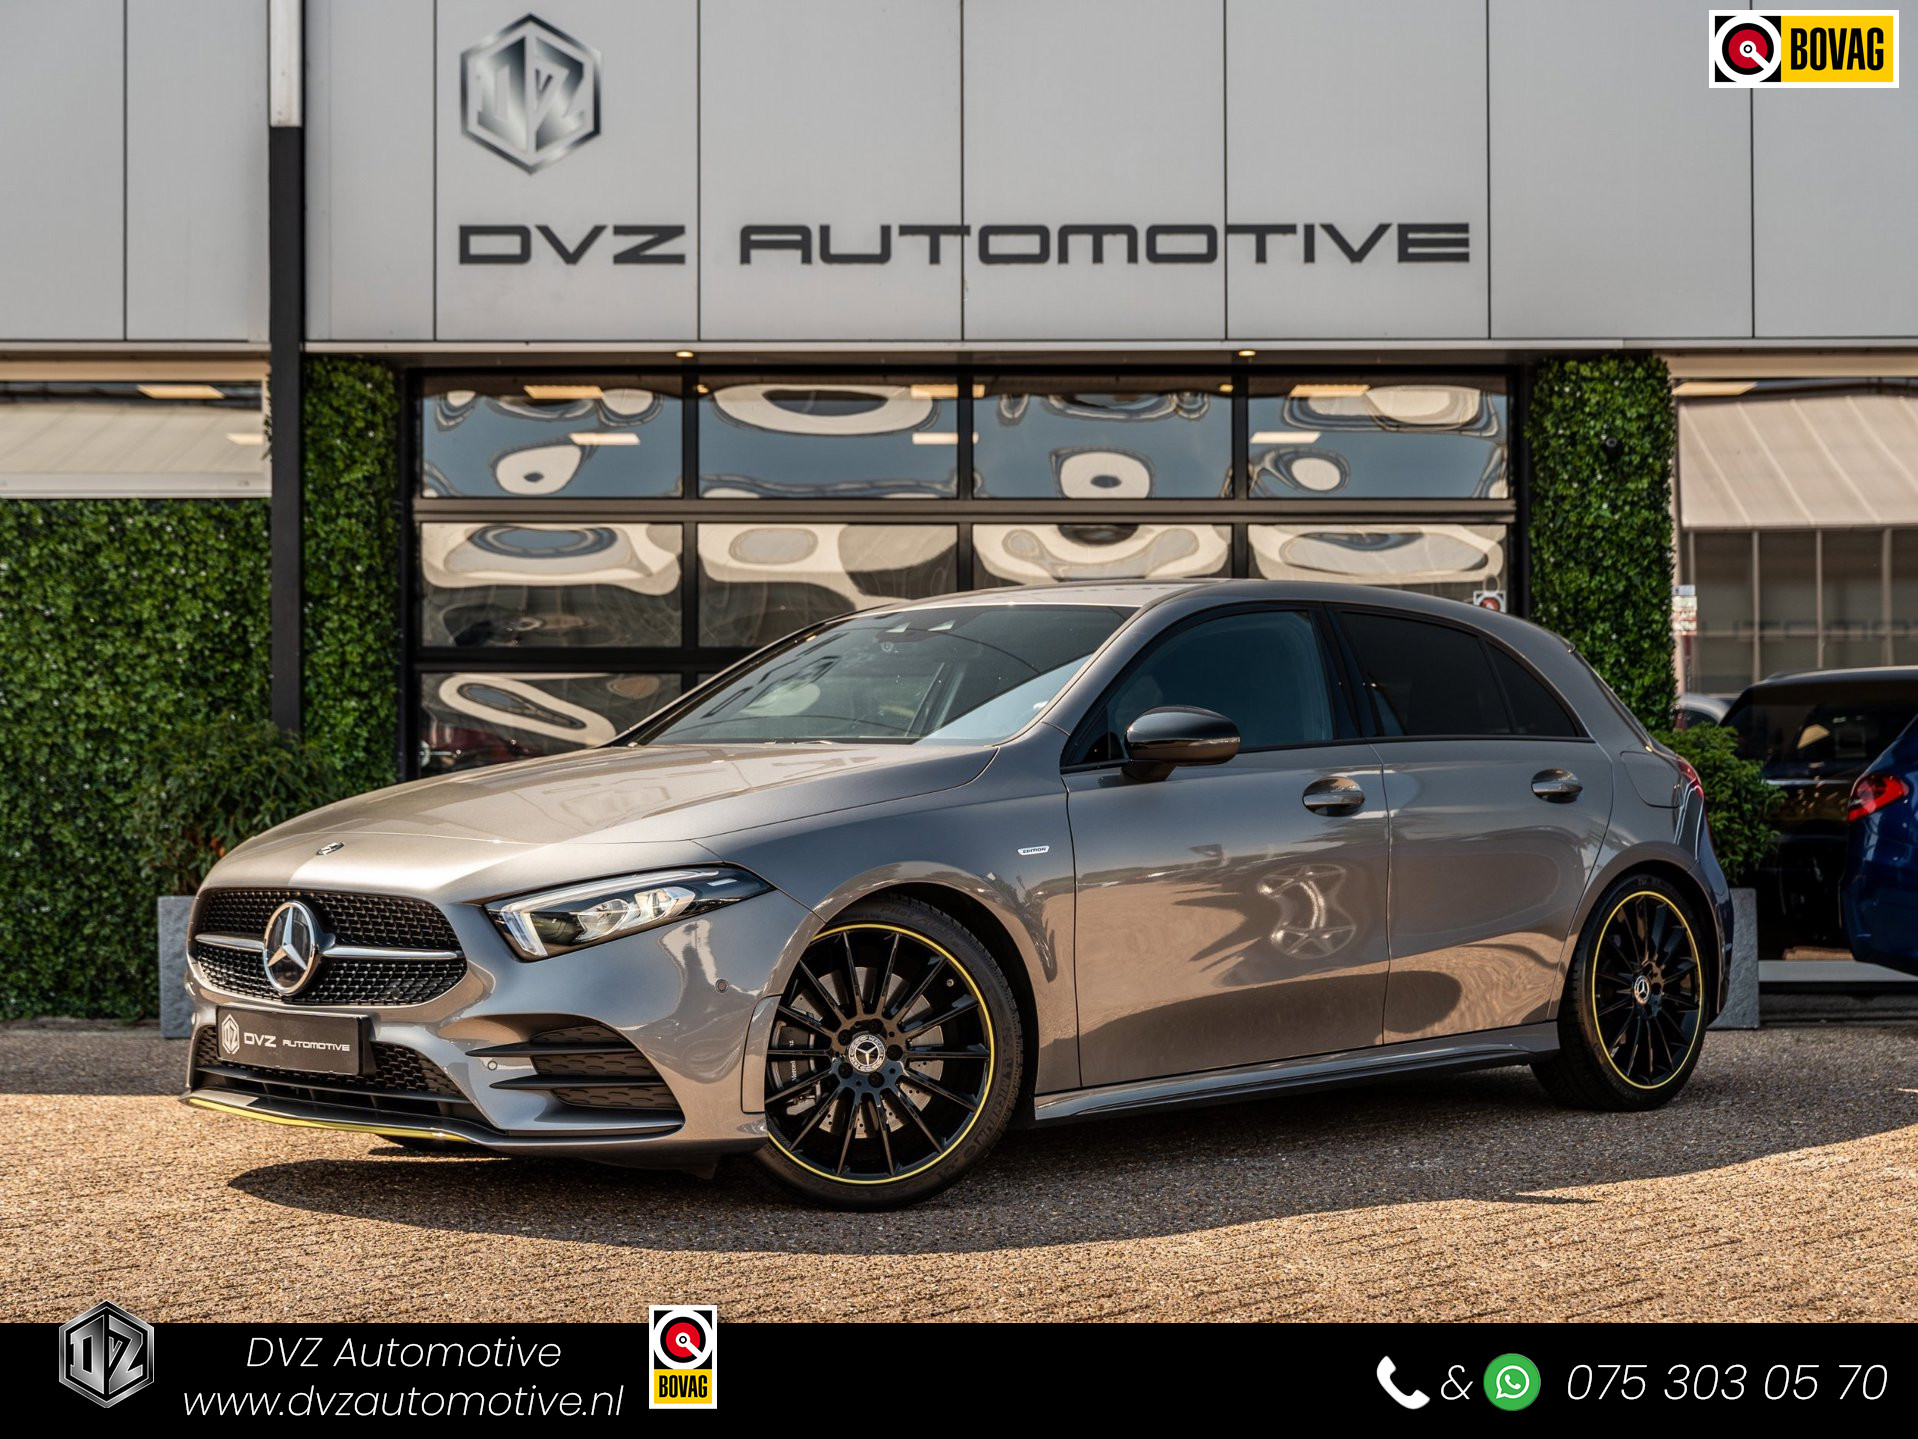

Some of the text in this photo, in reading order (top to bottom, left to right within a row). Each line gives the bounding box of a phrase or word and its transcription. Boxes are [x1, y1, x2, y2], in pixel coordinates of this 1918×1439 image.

[458, 223, 1471, 265] DVZ AUTOMOTIVE
[1021, 846, 1047, 855] EDITION
[243, 1032, 351, 1052] DVZ AUTOMOTIVE
